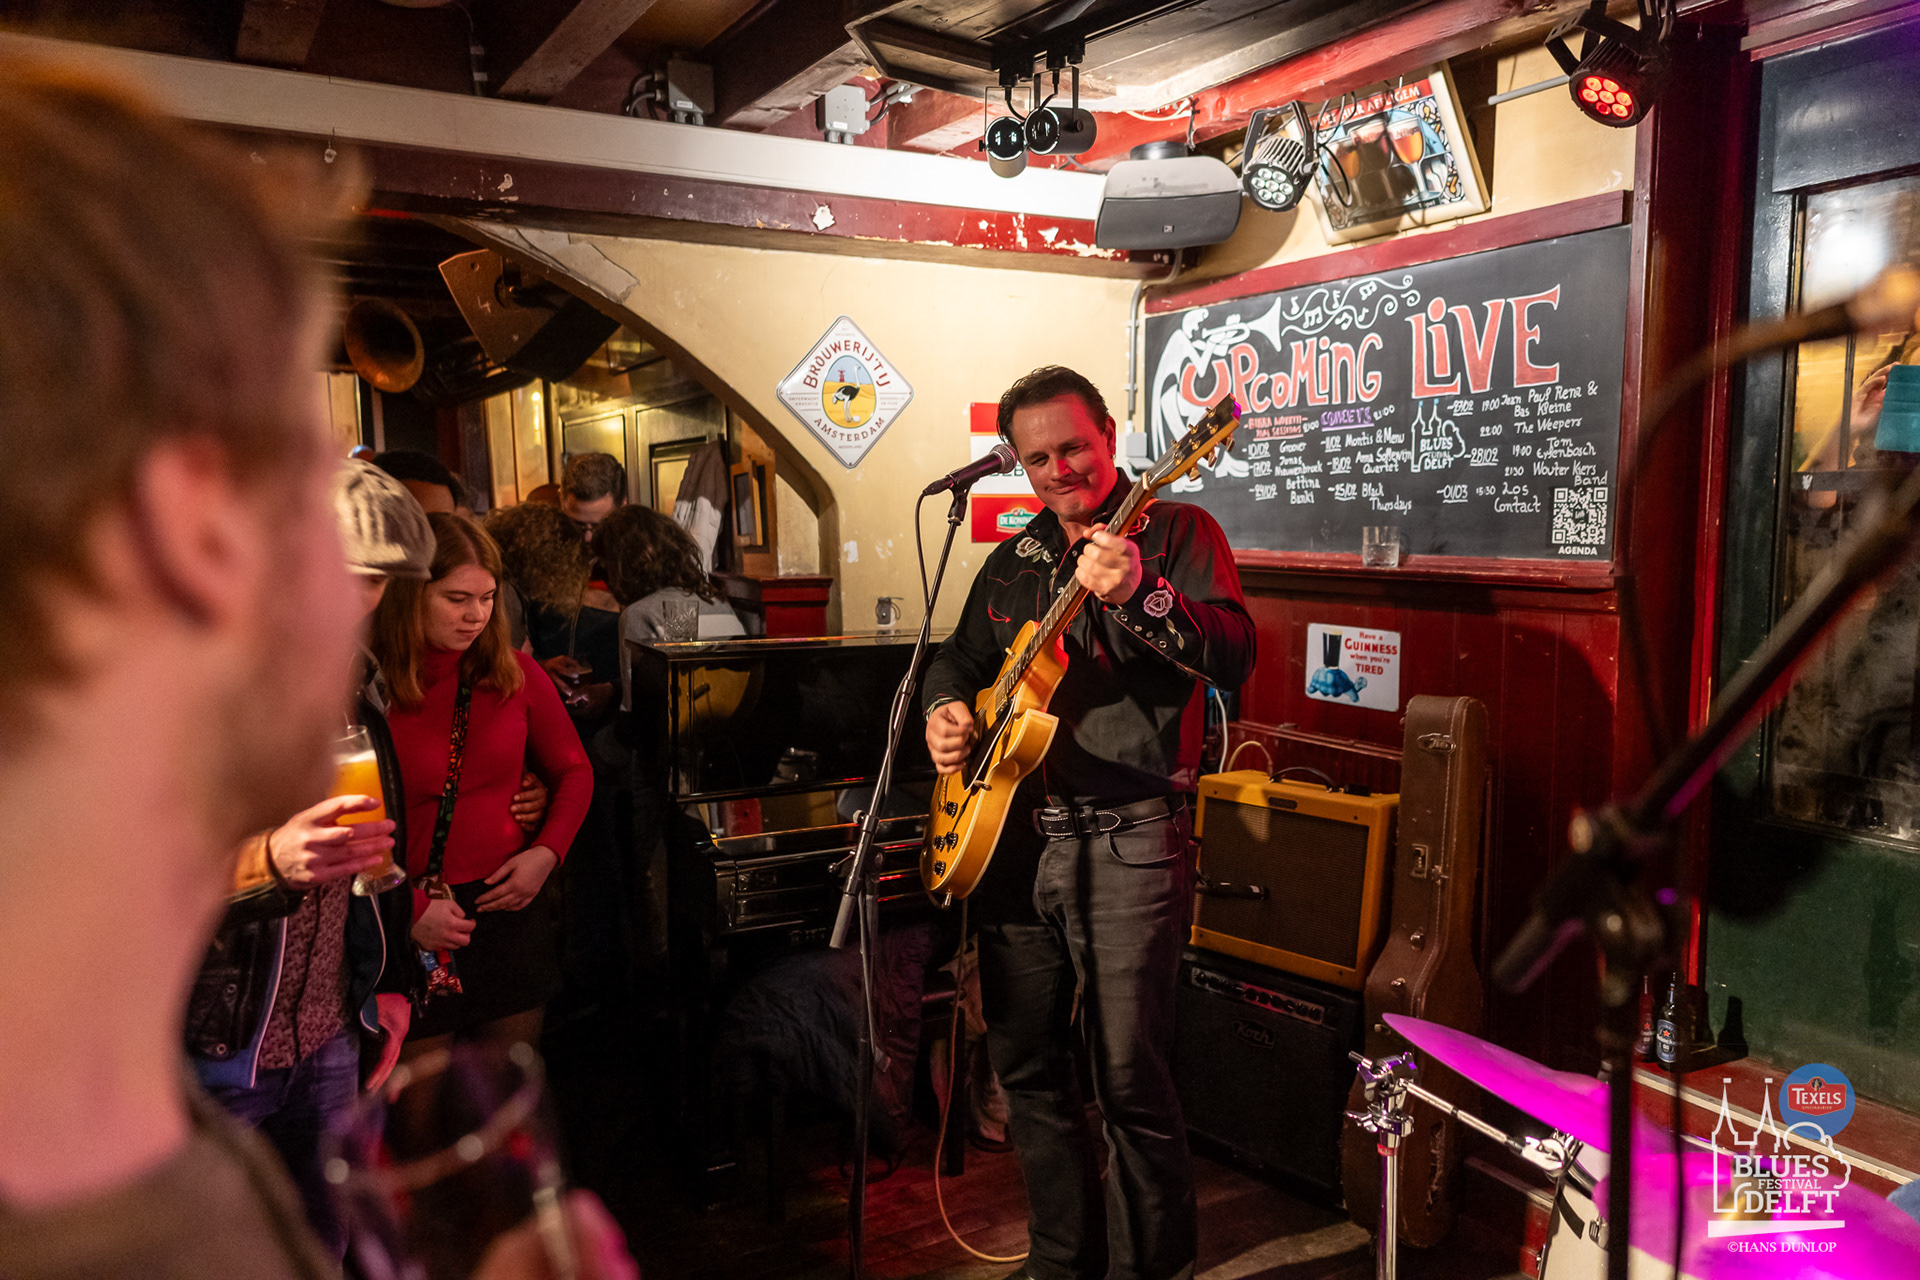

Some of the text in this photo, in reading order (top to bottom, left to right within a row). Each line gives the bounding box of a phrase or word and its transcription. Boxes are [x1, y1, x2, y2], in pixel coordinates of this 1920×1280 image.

[1587, 380, 1598, 396] &
[1513, 405, 1530, 417] Bas
[814, 417, 885, 441] AMSTERDAM
[1513, 422, 1534, 434] The
[1537, 417, 1582, 432] Weepers
[1375, 428, 1383, 444] &
[1420, 436, 1453, 452] BLUES
[1546, 437, 1573, 448] Tom
[1424, 455, 1454, 470] DELFT
[1533, 461, 1569, 477] Wouter
[1574, 470, 1608, 487] Band
[1361, 482, 1384, 497] Black
[1494, 495, 1541, 513] Contact
[1558, 546, 1597, 556] AGENDA
[1359, 631, 1376, 640] Have
[1344, 638, 1397, 655] GUINNESS
[1350, 653, 1391, 664] when you're
[1355, 663, 1384, 675] TIRED
